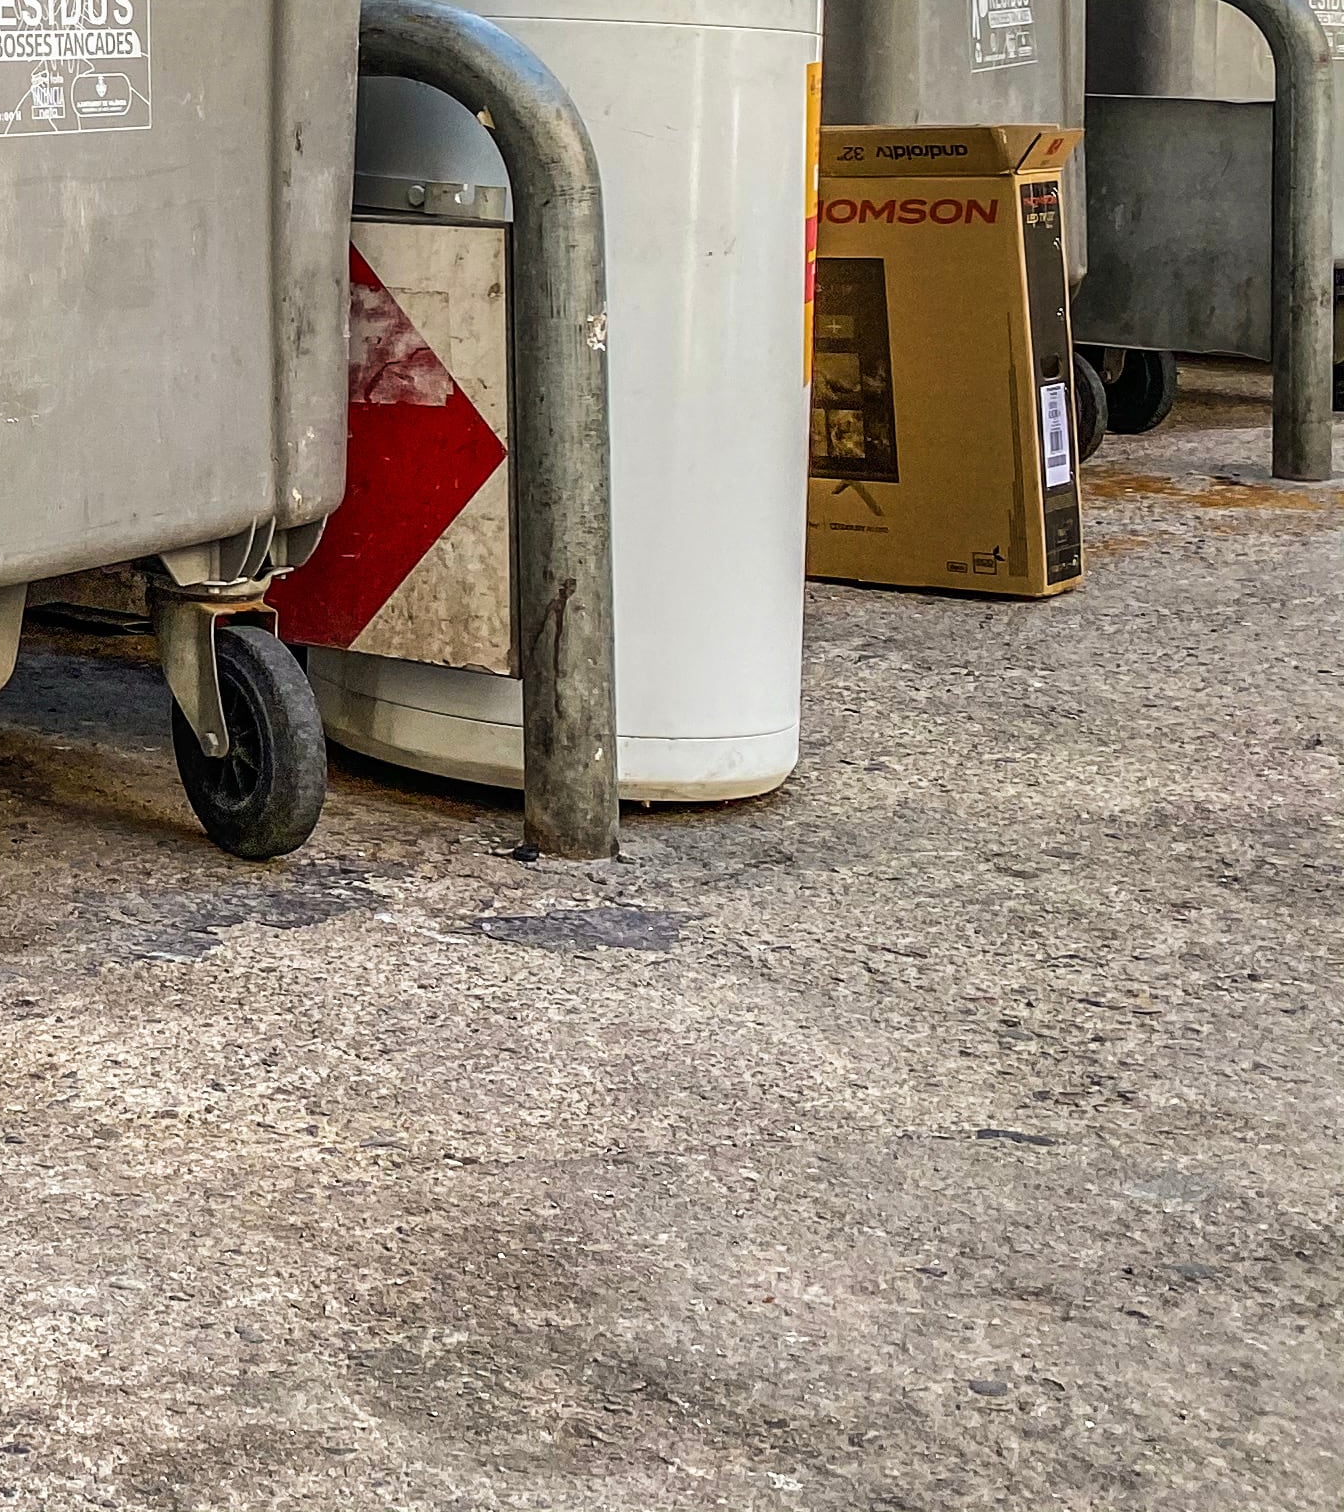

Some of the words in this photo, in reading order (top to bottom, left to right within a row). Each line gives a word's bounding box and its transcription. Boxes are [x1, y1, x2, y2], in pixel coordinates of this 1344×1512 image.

[55, 32, 133, 57] TANCADES
[876, 144, 968, 161] androidtv
[817, 198, 999, 224] OMSON
